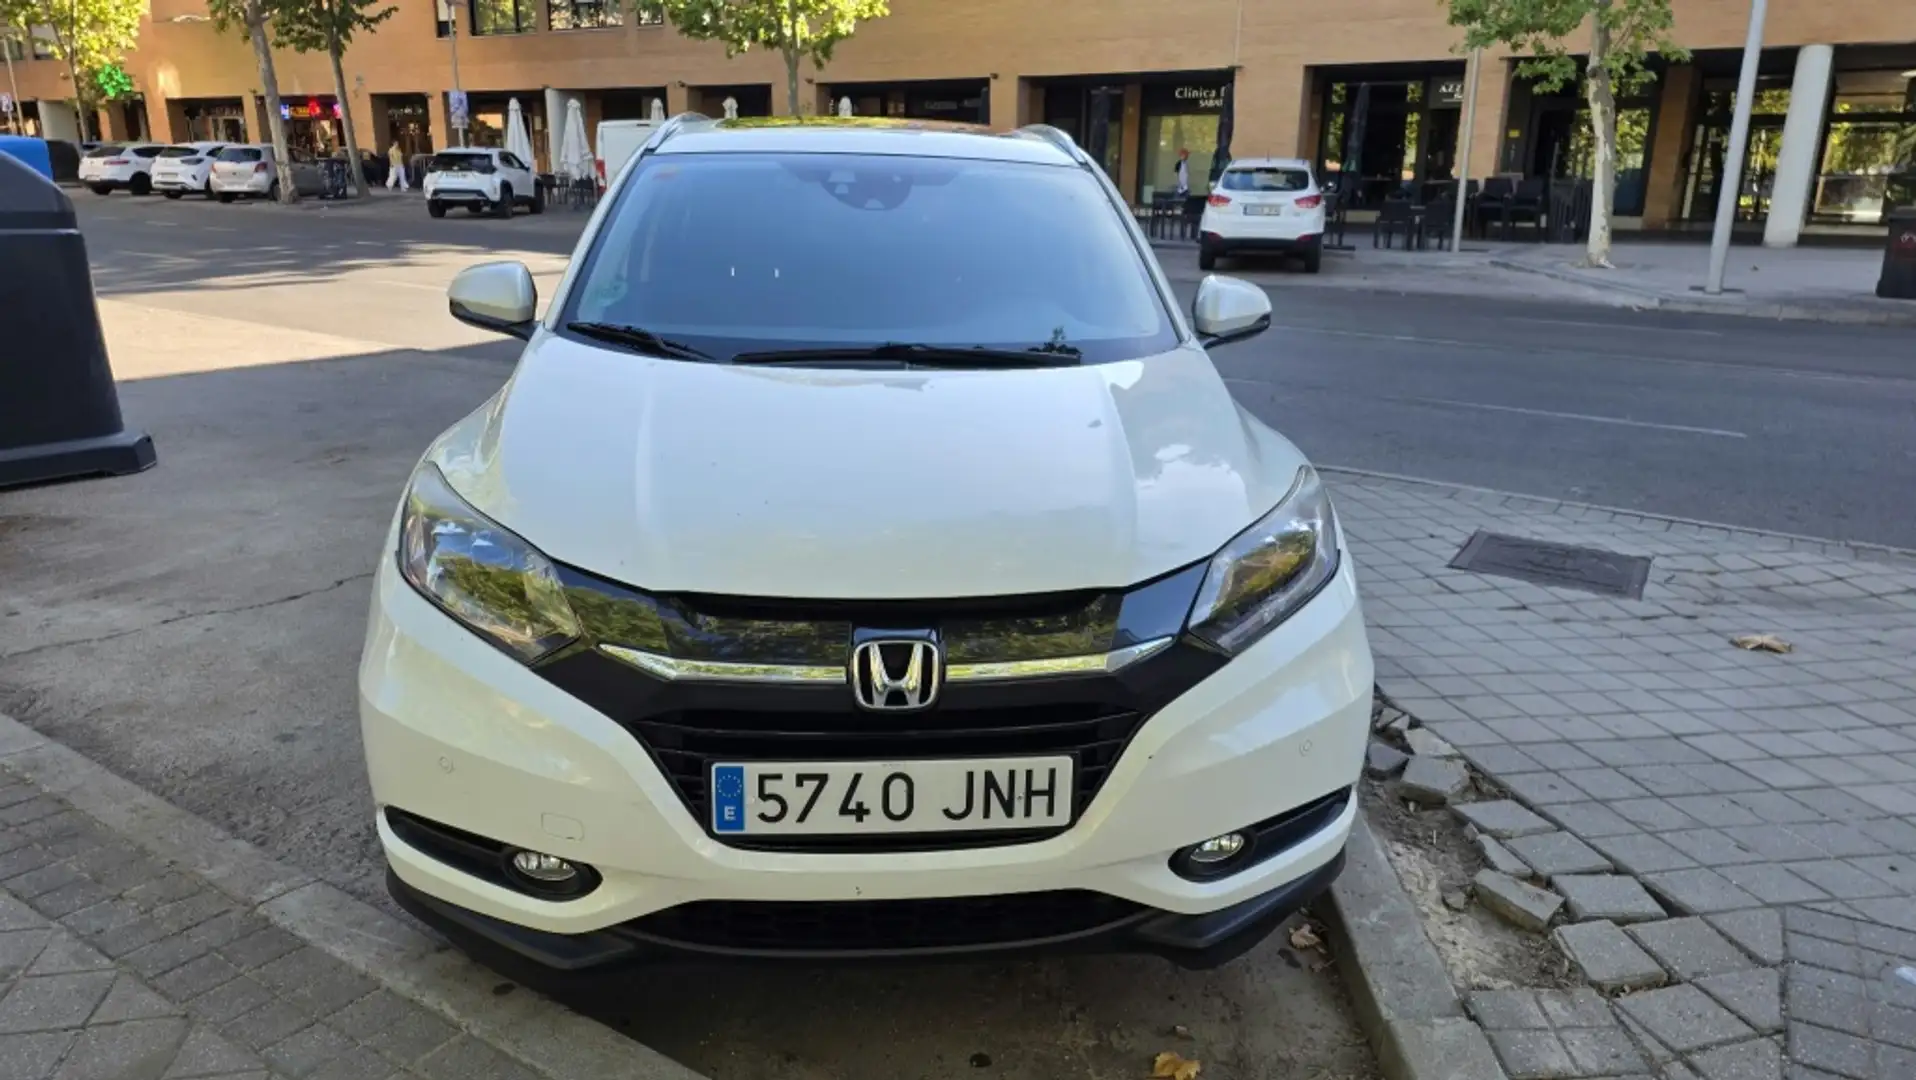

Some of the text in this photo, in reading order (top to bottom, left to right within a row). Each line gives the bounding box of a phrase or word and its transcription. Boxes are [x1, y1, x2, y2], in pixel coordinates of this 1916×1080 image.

[723, 805, 737, 821] E
[757, 767, 1056, 824] 5740 JNH
